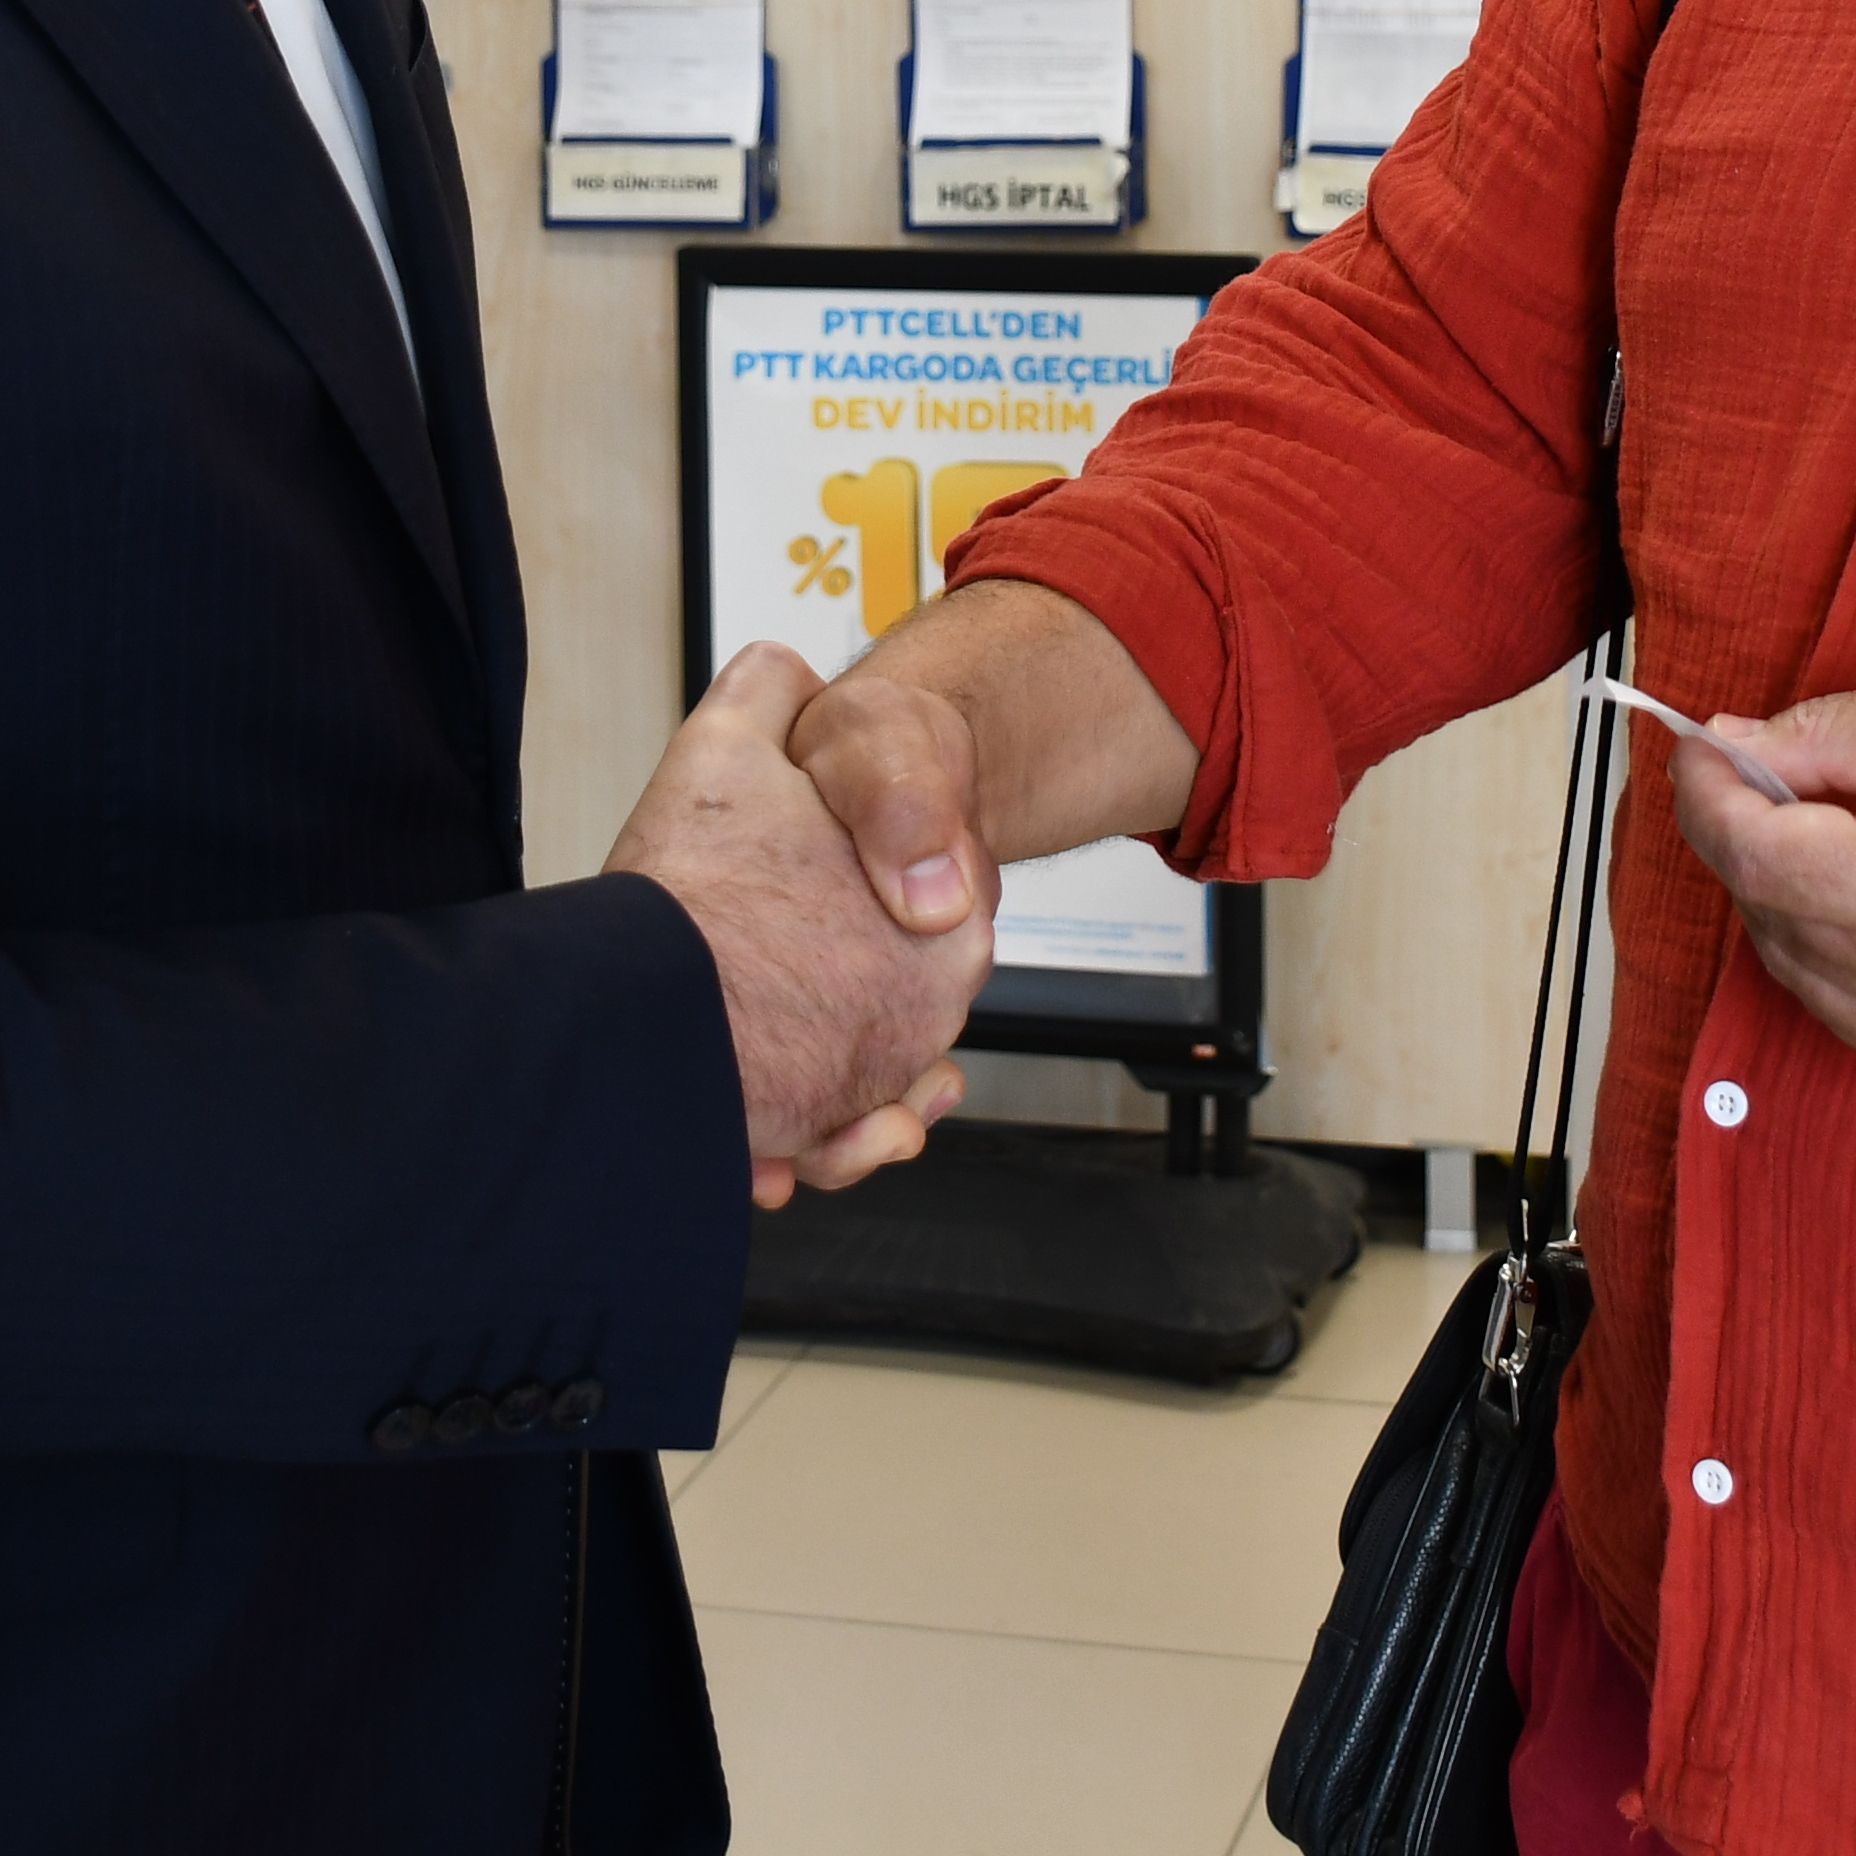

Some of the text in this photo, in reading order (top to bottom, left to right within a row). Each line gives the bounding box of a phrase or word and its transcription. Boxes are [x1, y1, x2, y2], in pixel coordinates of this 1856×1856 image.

[937, 177, 1088, 212] HGS İPTAL
[822, 308, 1081, 338] PTTCELL'DEN
[733, 347, 1172, 394] PTT KARGODA GEÇERLİ
[812, 387, 1094, 433] DEV İNDİRİM
